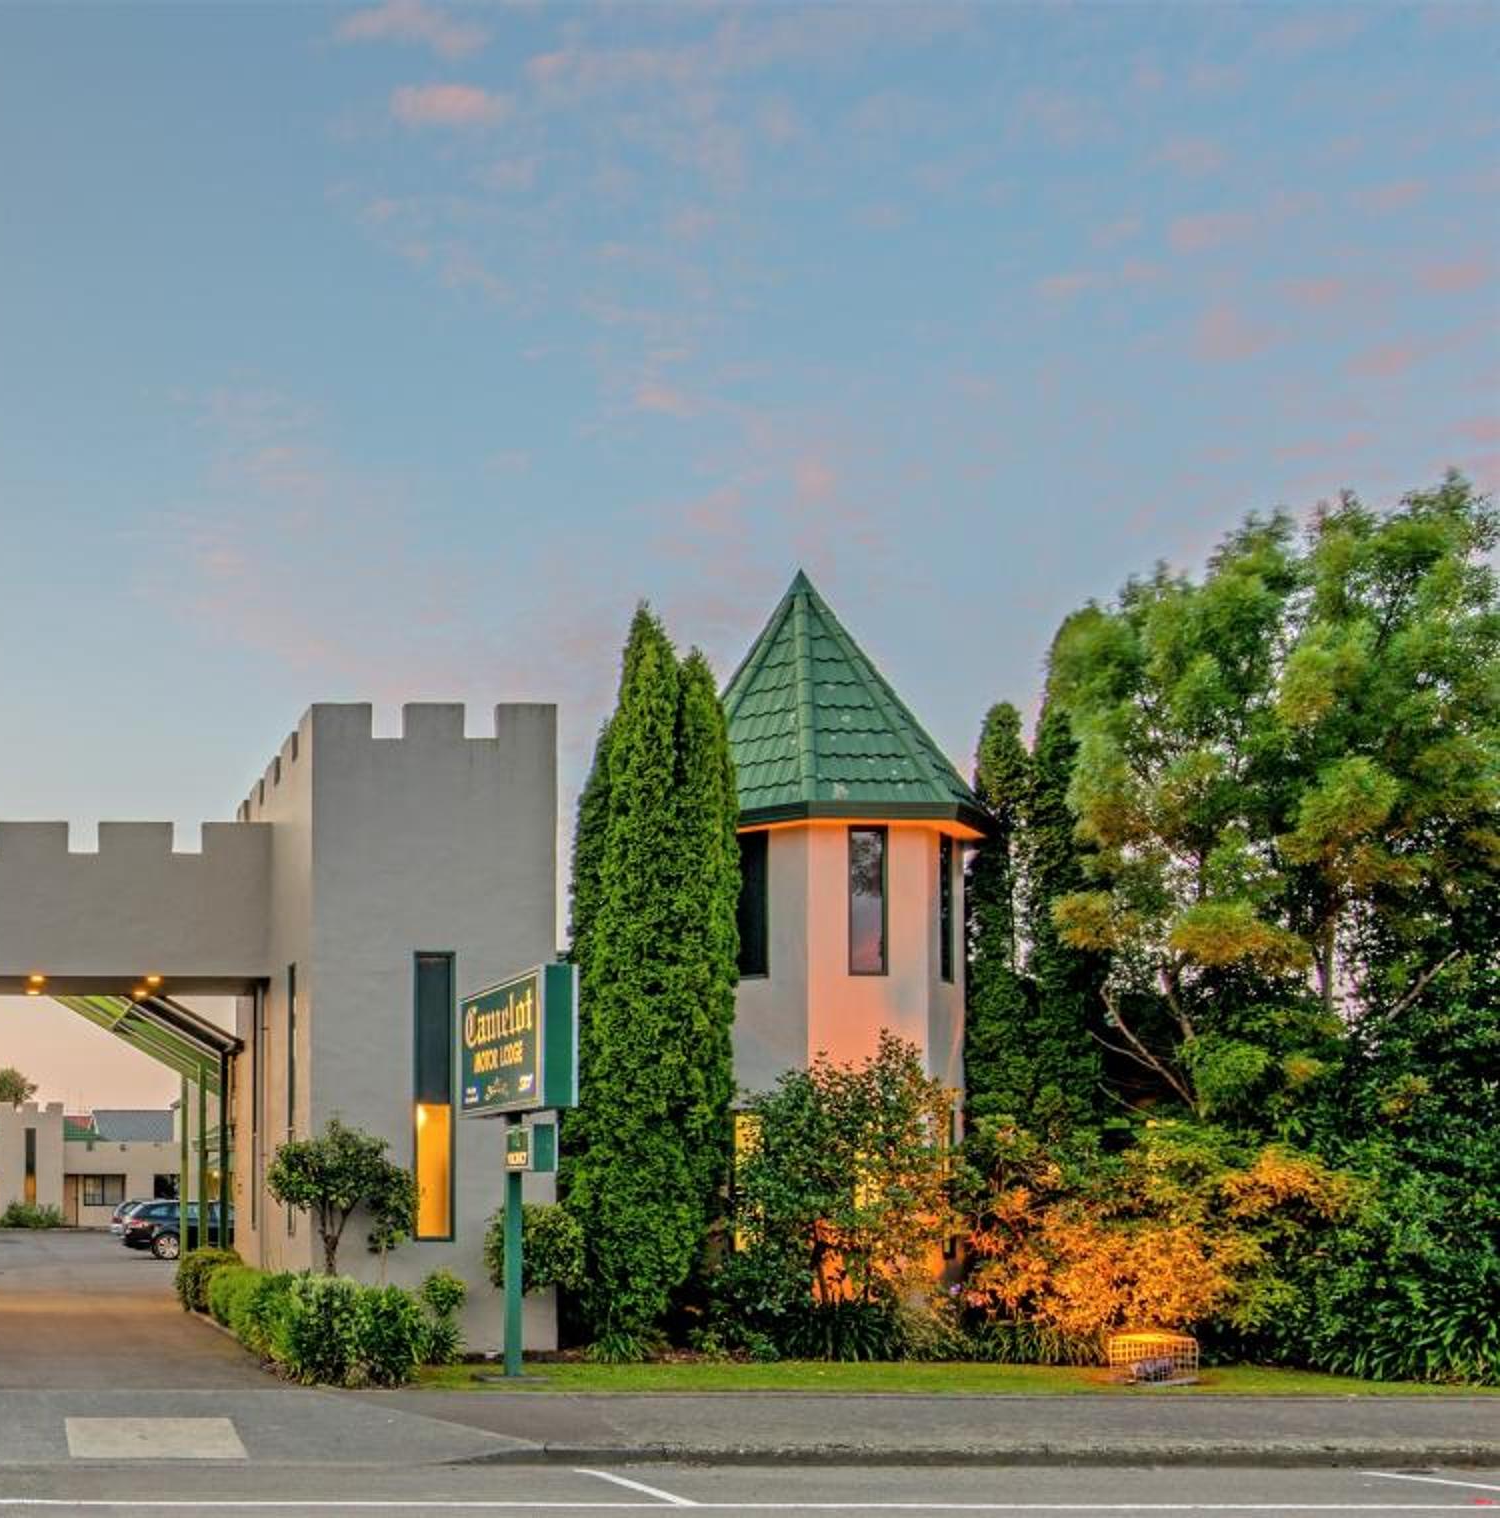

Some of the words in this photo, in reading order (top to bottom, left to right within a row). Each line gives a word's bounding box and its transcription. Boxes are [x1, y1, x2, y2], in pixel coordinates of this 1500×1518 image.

[465, 988, 532, 1048] Camelot
[474, 1048, 498, 1073] MOTOR
[500, 1041, 523, 1067] LODGE
